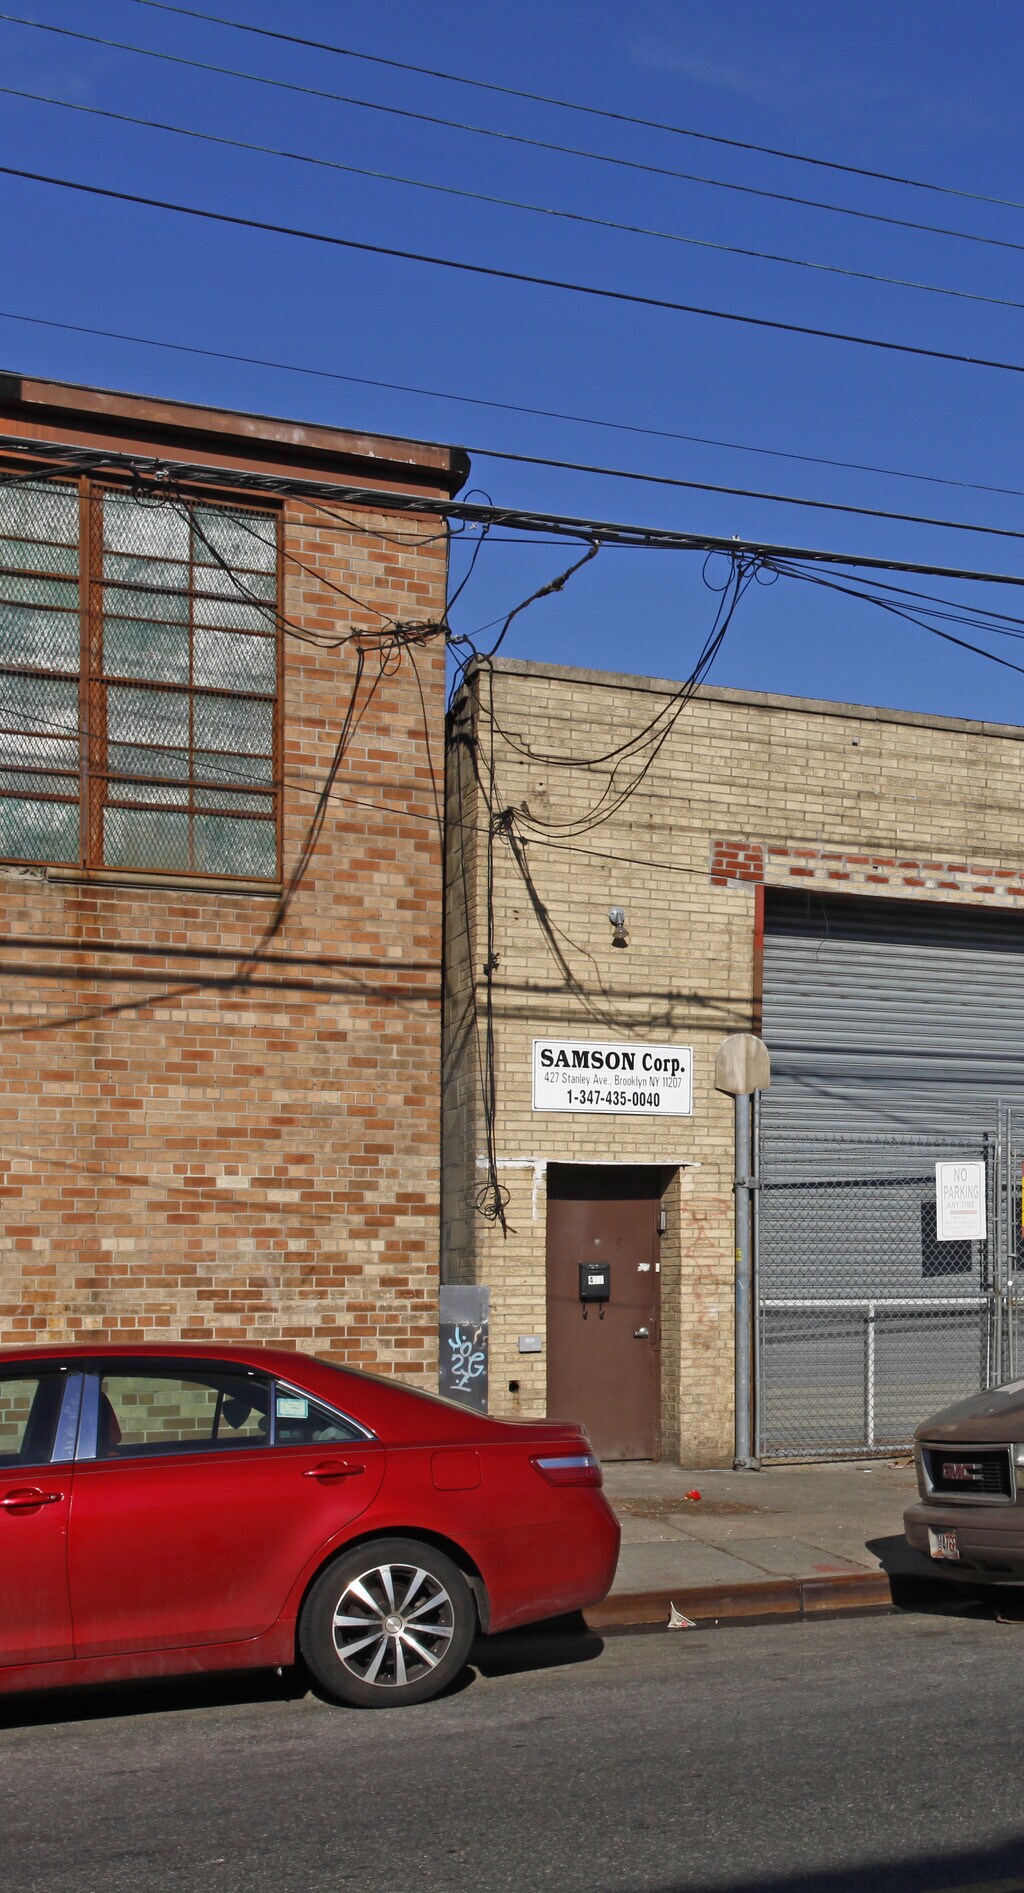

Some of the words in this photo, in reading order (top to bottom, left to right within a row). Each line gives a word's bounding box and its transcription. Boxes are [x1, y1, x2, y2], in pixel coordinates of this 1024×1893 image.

[541, 1048, 635, 1070] SAMSON
[642, 1052, 686, 1077] Corp.
[544, 1072, 560, 1083] 427
[561, 1073, 591, 1087] Stanley
[614, 1075, 648, 1088] Brooklyn
[649, 1076, 660, 1088] NY
[662, 1076, 682, 1088] 11207
[566, 1089, 661, 1107] 1-347-435-0040
[953, 1167, 968, 1182] NO
[943, 1184, 979, 1200] PARKING
[946, 1200, 960, 1209] ANY
[960, 1200, 975, 1208] TIME
[942, 1463, 976, 1480] GMC
